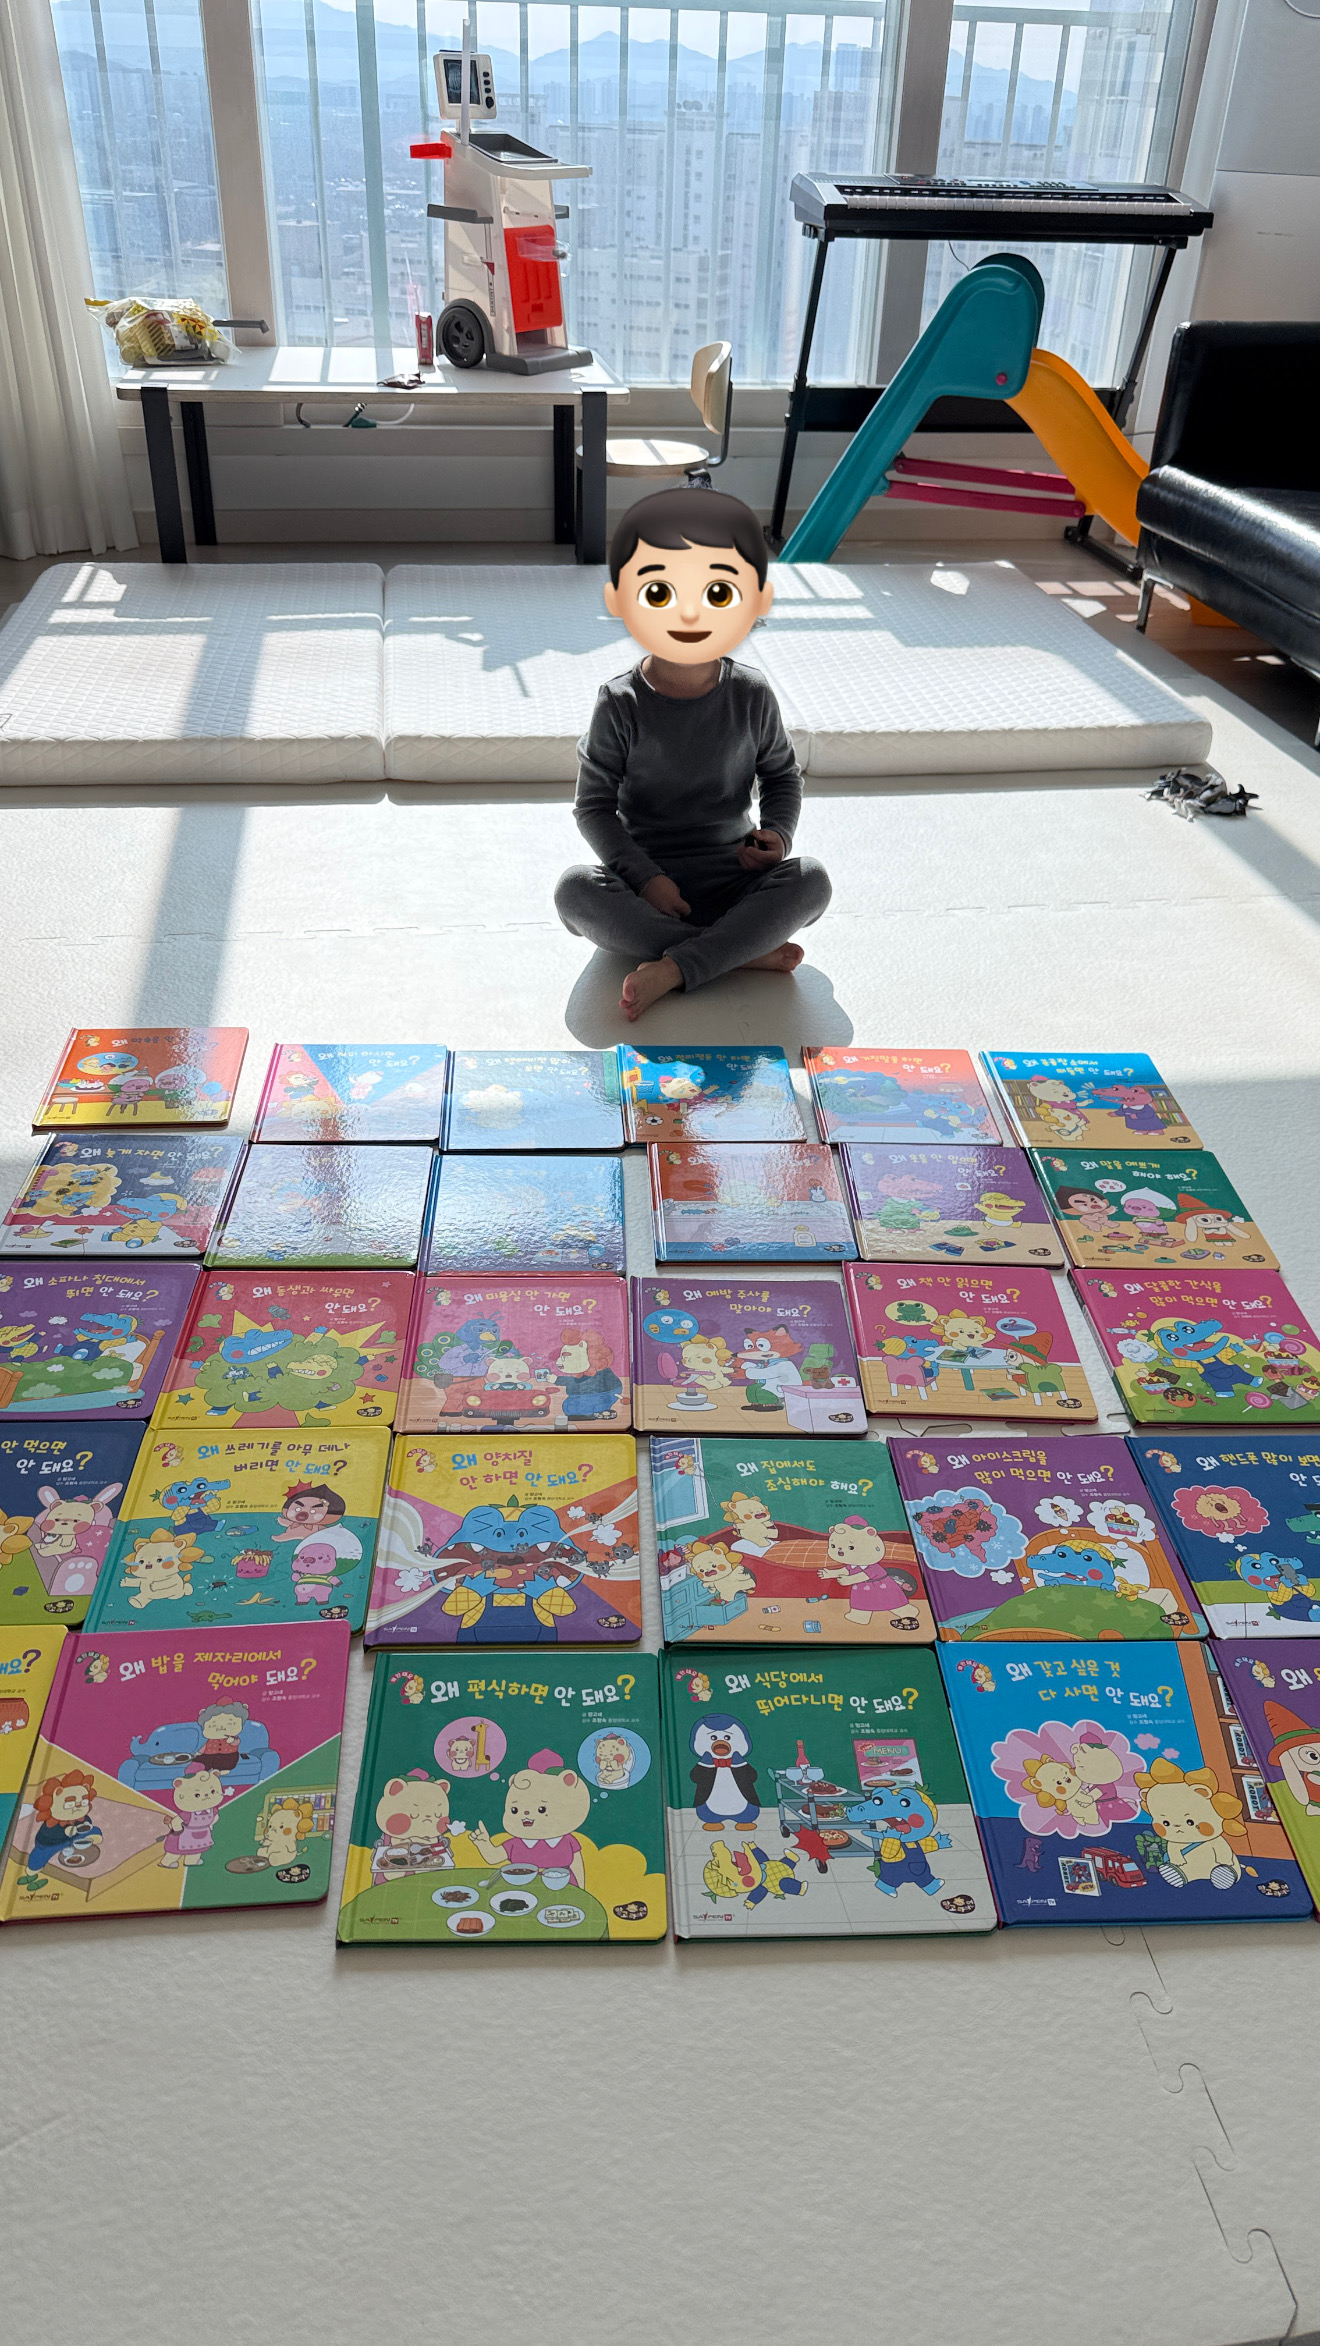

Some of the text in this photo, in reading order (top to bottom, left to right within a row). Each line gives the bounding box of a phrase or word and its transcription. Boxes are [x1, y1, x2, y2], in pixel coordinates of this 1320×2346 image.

[842, 1055, 859, 1064] 왜
[1022, 1059, 1039, 1068] 왜
[902, 1063, 951, 1074] 안 돼요?
[1087, 1067, 1100, 1075] 안
[1103, 1067, 1134, 1077] 돼요?
[80, 1148, 101, 1159] 왜
[134, 1149, 165, 1160] 자면
[167, 1151, 183, 1161] 안
[185, 1146, 224, 1161] 돼요?
[889, 1153, 978, 1165] 왜 옷을 안 입으면
[957, 1165, 1006, 1177] 안 돼요?
[1080, 1160, 1161, 1171] 왜 말을 예쁘게
[1132, 1168, 1198, 1182] 해야 해요?
[23, 1273, 146, 1289] 왜 소파나 침대에서
[896, 1276, 993, 1290] 왜 책 안 읽으면
[1123, 1279, 1223, 1295] 왜 달콤한 간식을
[66, 1286, 160, 1302] 뛰면 안 돼요?
[252, 1284, 356, 1299] 왜 동생과 싸우면
[463, 1290, 571, 1305] 왜 미용실 안 가면
[683, 1288, 770, 1303] 왜 예방 주사를
[958, 1287, 1021, 1304] 안 돼요?
[325, 1297, 382, 1314] 안 돼요?
[533, 1298, 597, 1317] 안 돼요?
[1149, 1294, 1273, 1310] 많이 먹으면 안 돼요?
[729, 1303, 811, 1318] 맞아야 돼요?
[1, 1440, 67, 1455] 안 먹으면
[197, 1440, 350, 1460] 왜 쓰레기를 아무 데나
[16, 1451, 94, 1475] 안 돼요?
[233, 1459, 348, 1476] 버리면 안 돼요?
[451, 1450, 533, 1471] 왜 양치질
[946, 1449, 1048, 1470] 왜 아이스크림을
[1195, 1451, 1320, 1472] 왜 핸드폰 많이 보면
[735, 1459, 817, 1478] 왜 집에서도
[973, 1465, 1115, 1485] 많이 먹으면 안 돼요?
[459, 1463, 594, 1491] 안 하면 안 돼요?
[1289, 1472, 1308, 1487] 안
[764, 1476, 874, 1497] 조심해야 해요?
[118, 1649, 282, 1682] 왜 밥을 제자리에서
[1005, 1659, 1121, 1682] 왜 갖고 싶은 것
[207, 1657, 317, 1691] 먹어야 돼요?
[1280, 1667, 1314, 1691] 왜
[430, 1674, 636, 1707] 왜 편식하면 안 돼요?
[724, 1671, 824, 1694] 왜 식당에서
[755, 1687, 919, 1717] 뛰어다니면 안 돼요?
[1037, 1684, 1174, 1708] 다 사면 안 돼요?
[873, 1747, 902, 1755] MENU
[1249, 1783, 1260, 1812] ROBOT
[693, 1911, 724, 1922] SAYPEN
